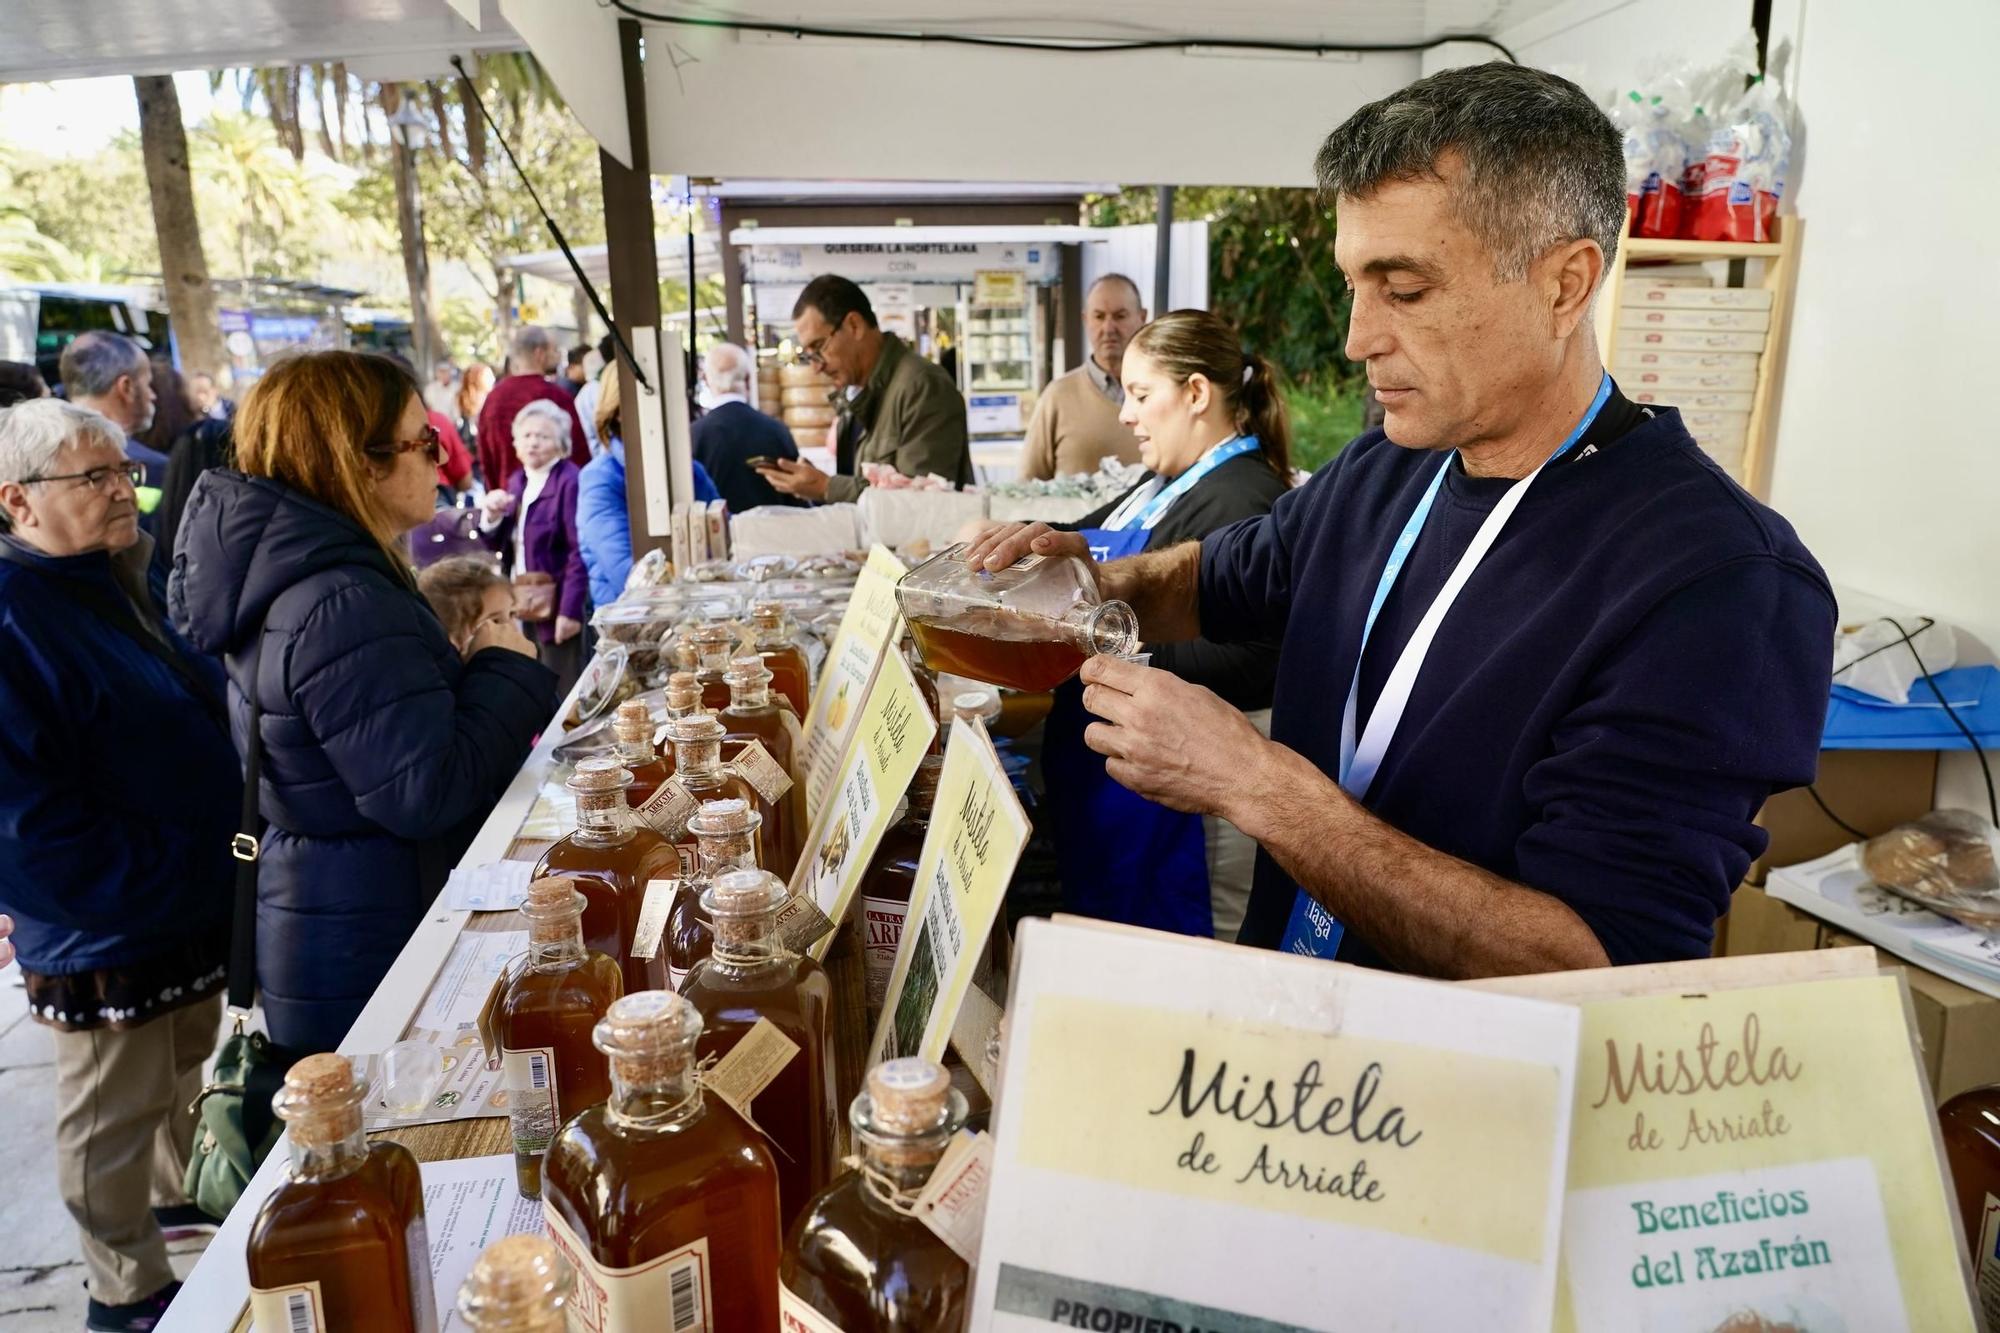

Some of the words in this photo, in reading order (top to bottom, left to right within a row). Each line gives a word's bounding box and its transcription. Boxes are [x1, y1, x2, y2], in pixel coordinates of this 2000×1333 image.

[887, 243, 903, 254] LA
[880, 687, 912, 754] Mistela
[648, 788, 677, 817] ARRIATE
[959, 780, 996, 866] Mistela
[1592, 1012, 1803, 1110] Mistela
[1148, 1048, 1423, 1148] Mistela
[1627, 1111, 1664, 1151] de
[1676, 1099, 1792, 1152] Arriate
[1177, 1131, 1221, 1175] de
[1234, 1144, 1386, 1203] Arriate
[1630, 1188, 1810, 1235] Beneficios
[1631, 1251, 1685, 1289] del
[1694, 1234, 1832, 1281] Azafrán
